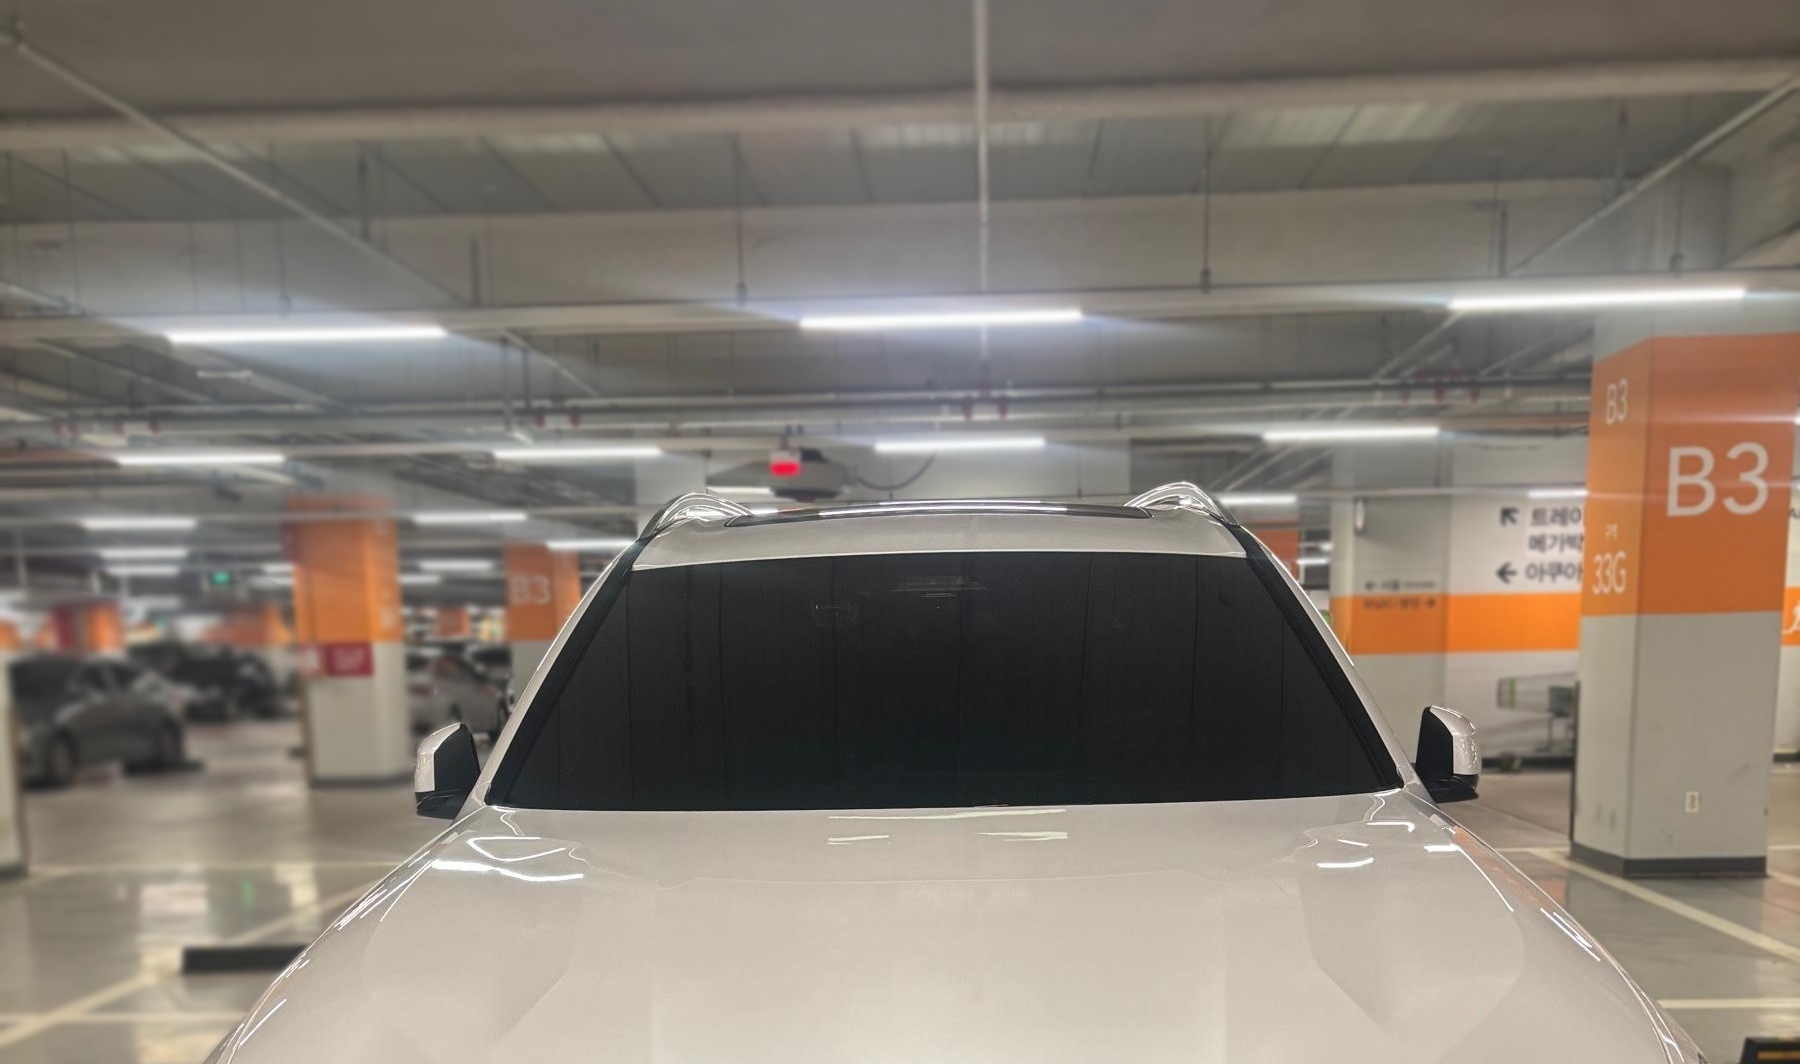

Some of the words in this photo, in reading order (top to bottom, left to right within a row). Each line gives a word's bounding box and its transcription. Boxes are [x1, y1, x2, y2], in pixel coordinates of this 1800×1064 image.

[1606, 378, 1628, 425] B3
[1667, 442, 1769, 517] B3
[510, 574, 550, 605] B3
[1592, 551, 1626, 595] 33G
